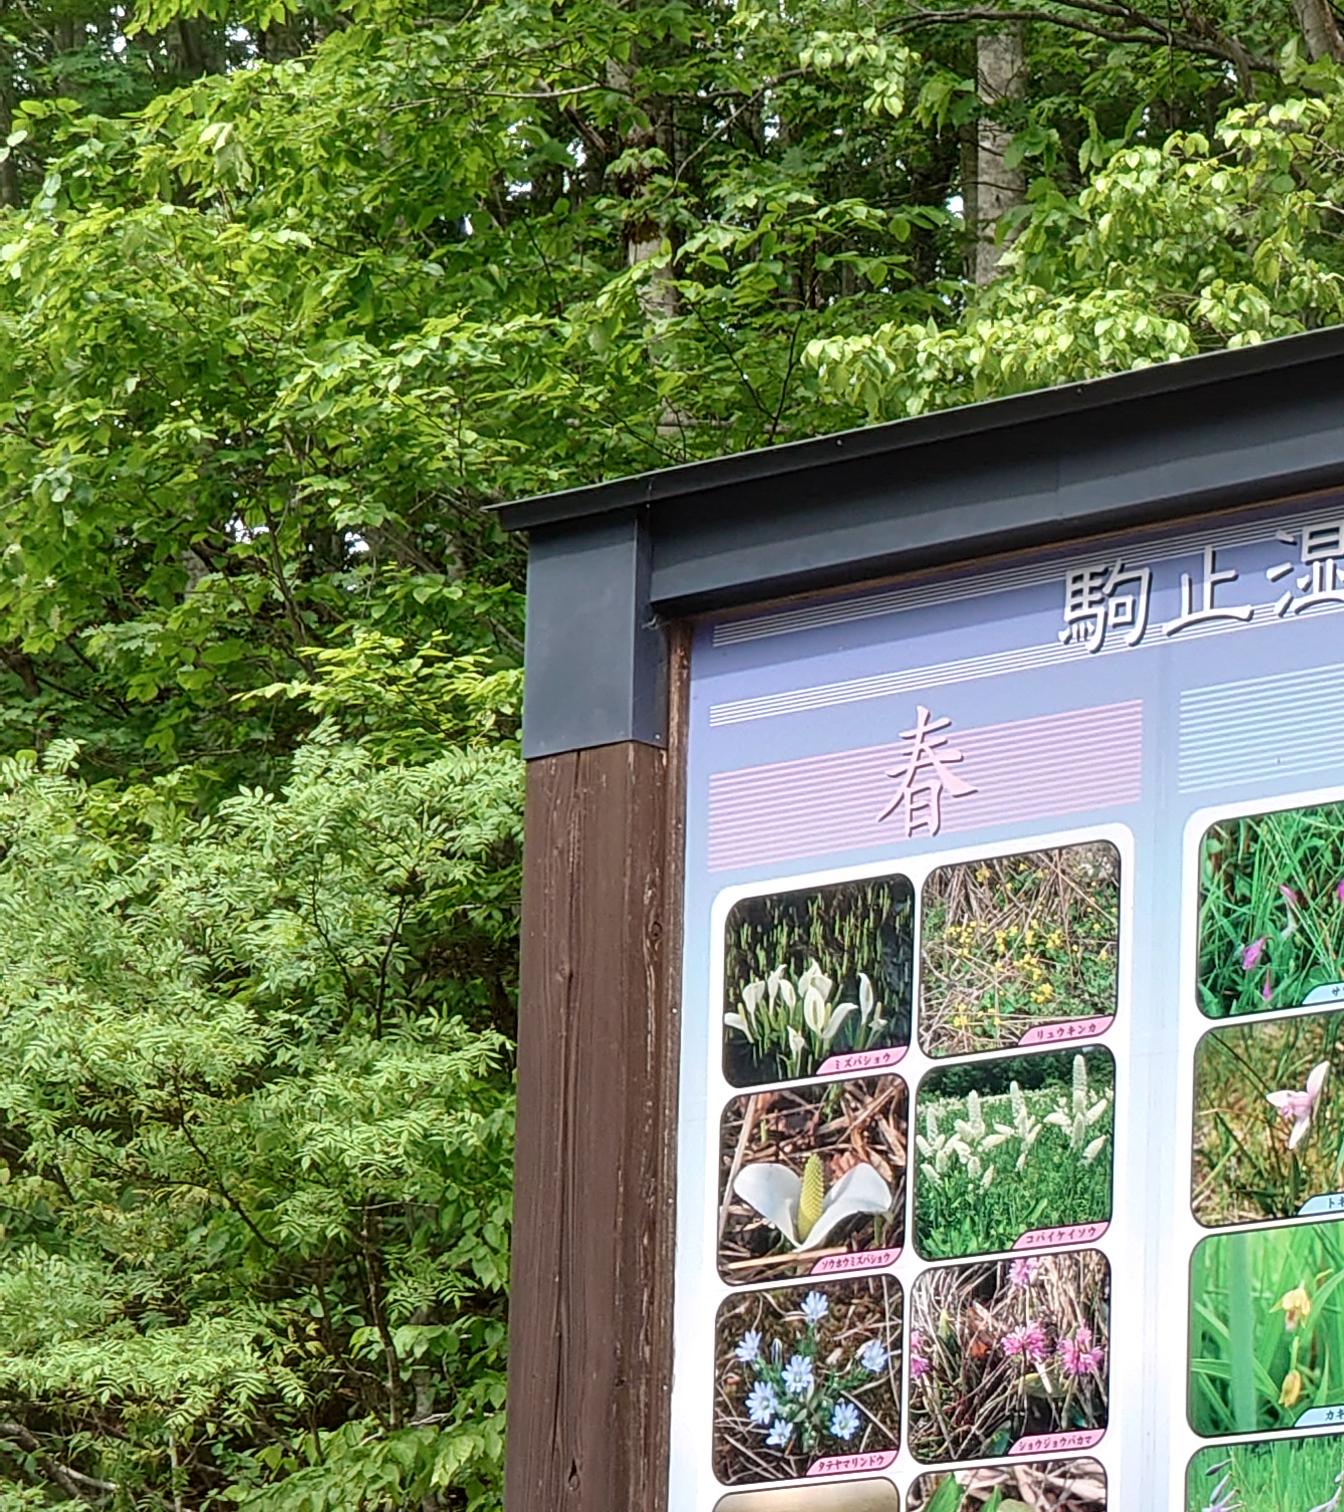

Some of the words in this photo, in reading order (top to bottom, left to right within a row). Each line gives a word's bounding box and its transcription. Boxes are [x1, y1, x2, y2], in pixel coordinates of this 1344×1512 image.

[876, 702, 979, 837] 春
[1036, 1023, 1097, 1039] リュウキンカ
[835, 1053, 891, 1070] ミズバショウ
[1026, 1227, 1097, 1244] コバイケイソウ
[821, 1253, 890, 1268] ソウホウミズバショウ
[1018, 1435, 1092, 1451] ショウジョウバカマ
[818, 1455, 885, 1471] タテヤマリンドウ
